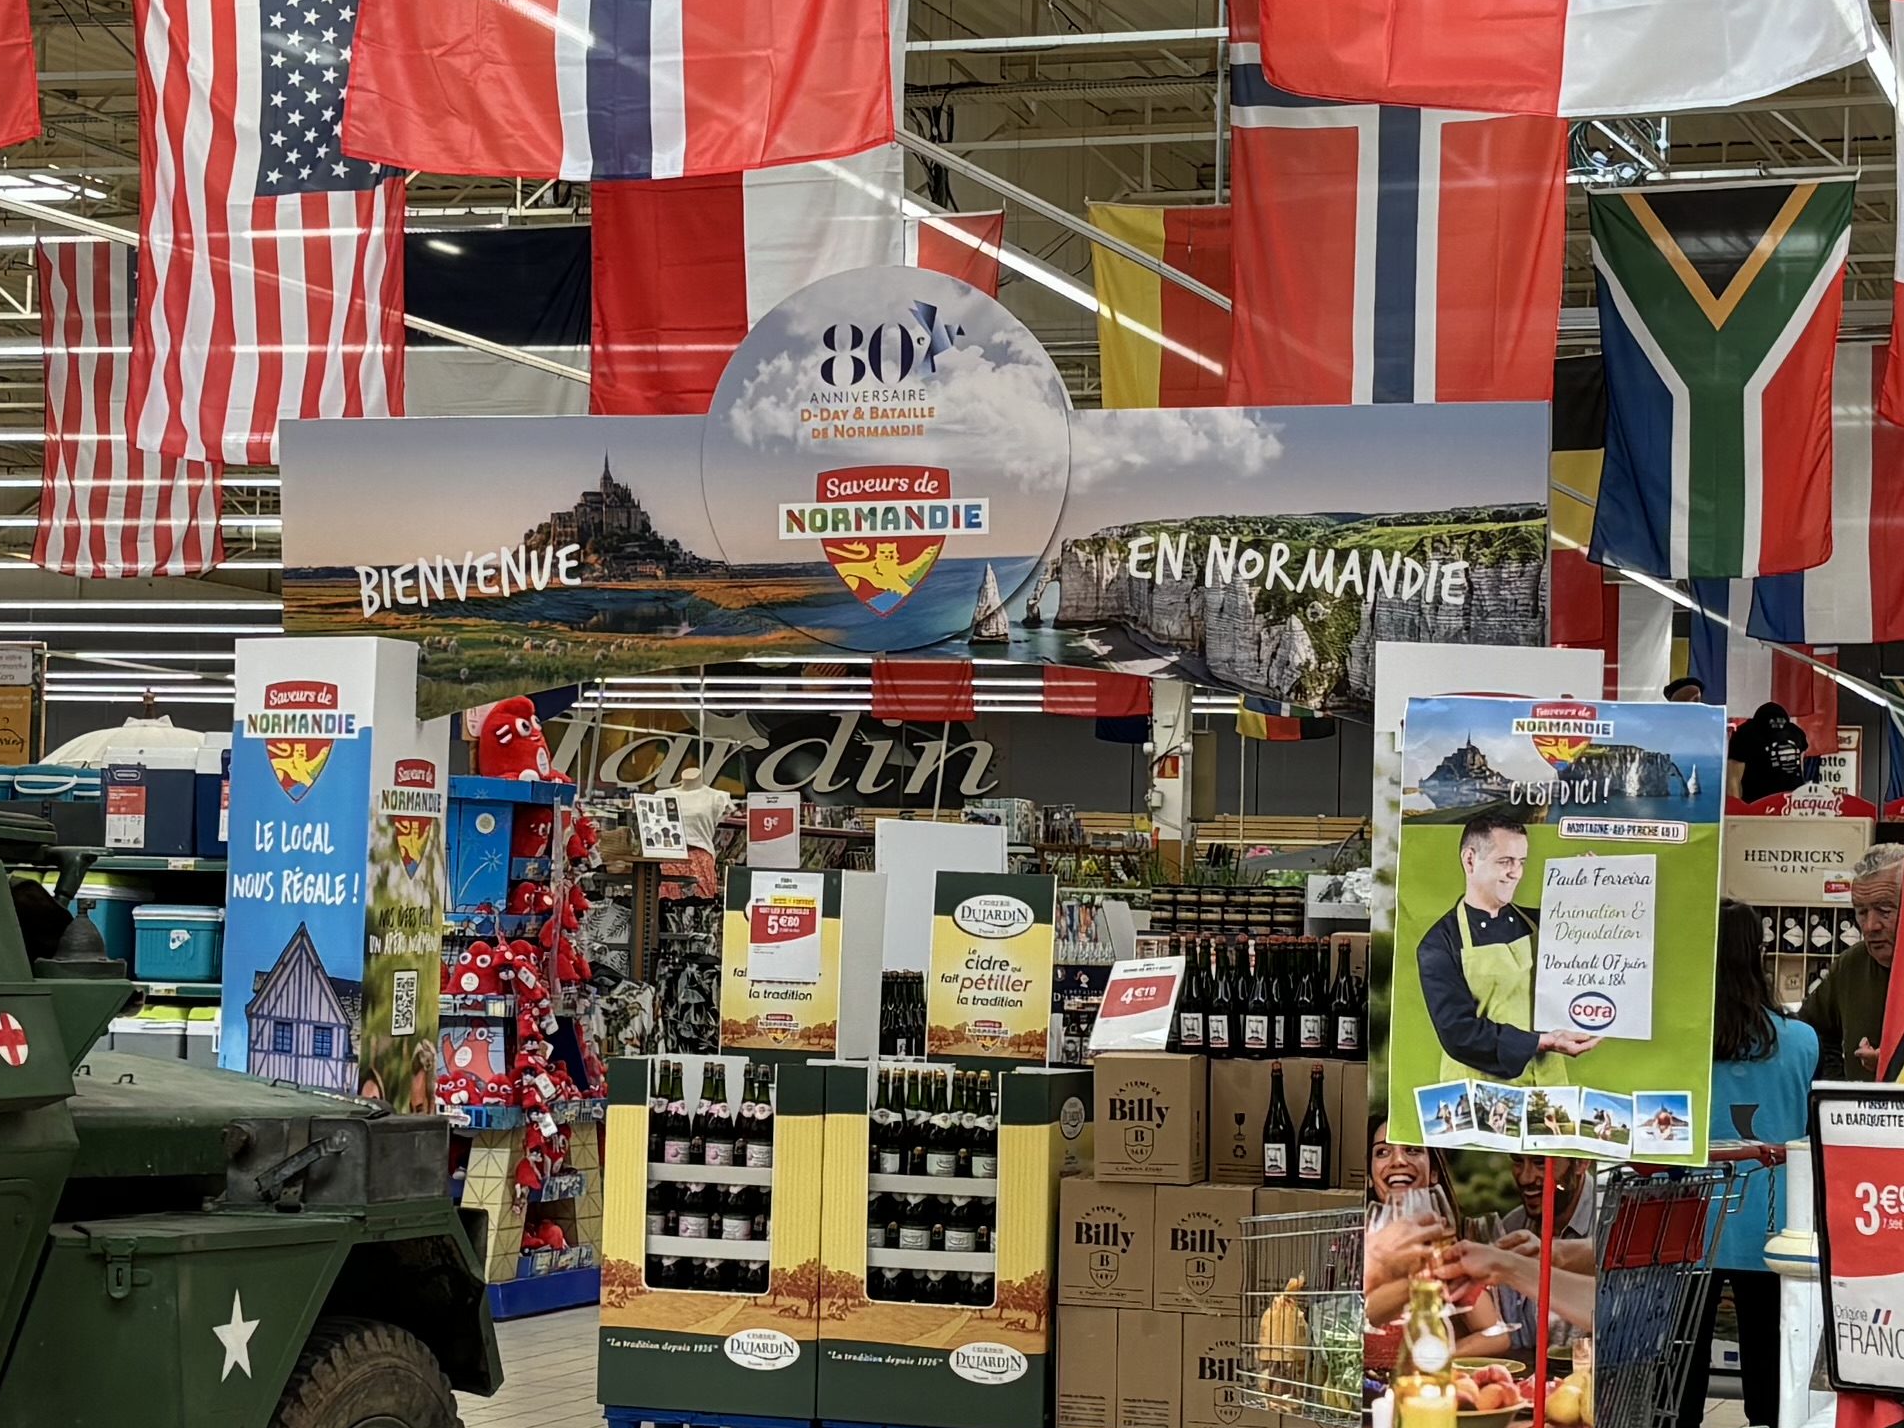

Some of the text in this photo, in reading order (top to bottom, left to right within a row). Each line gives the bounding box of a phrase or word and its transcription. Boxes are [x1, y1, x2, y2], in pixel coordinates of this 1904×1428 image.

[810, 389, 926, 405] ANNIVERSAIRE
[853, 407, 865, 421] &
[826, 471, 939, 498] Saveurs de
[785, 504, 983, 534] NORMANDIE
[1127, 532, 1470, 605] EN NORMANDIE
[354, 543, 582, 619] BIENVENUE
[269, 686, 332, 705] Saveurs de
[247, 713, 356, 735] NORMANDIE
[1515, 721, 1611, 735] NORMANDIE
[381, 789, 442, 813] NORMANDIE
[1510, 779, 1553, 806] C'EST
[1559, 779, 1597, 806] D'ICI
[1781, 793, 1844, 816] Jacquet
[763, 817, 779, 831] 9€
[255, 820, 335, 855] LE LOCAL
[1744, 849, 1845, 864] HENDRICK'S
[232, 866, 359, 906] NOUS RÉGALE !
[1546, 867, 1652, 887] Paulo Ferreira
[960, 905, 1028, 923] DUJARDIN
[1549, 901, 1646, 920] Animation &
[1555, 921, 1640, 945] Dégustation
[968, 947, 977, 955] Le
[964, 955, 1010, 971] cidre
[1543, 953, 1647, 975] Vendredi 07 juin
[940, 973, 1033, 994] fait pétiller
[748, 987, 813, 1001] la tradition
[956, 992, 1024, 1008] la tradition
[1572, 1003, 1612, 1018] cora
[1108, 1097, 1170, 1129] Billy
[1830, 1112, 1845, 1126] LA
[1845, 1113, 1904, 1128] BARQUETTE
[1134, 1129, 1145, 1142] B
[1074, 1221, 1135, 1254] Billy
[1170, 1228, 1232, 1261] Billy
[1099, 1254, 1110, 1266] B
[1196, 1261, 1206, 1273] B
[1833, 1302, 1868, 1325] Origine
[622, 1339, 691, 1353] tradition depuis
[729, 1337, 795, 1357] DUJARDIN
[843, 1352, 883, 1363] tradition
[955, 1351, 1022, 1374] DUJARDIN
[1223, 1389, 1234, 1403] B
